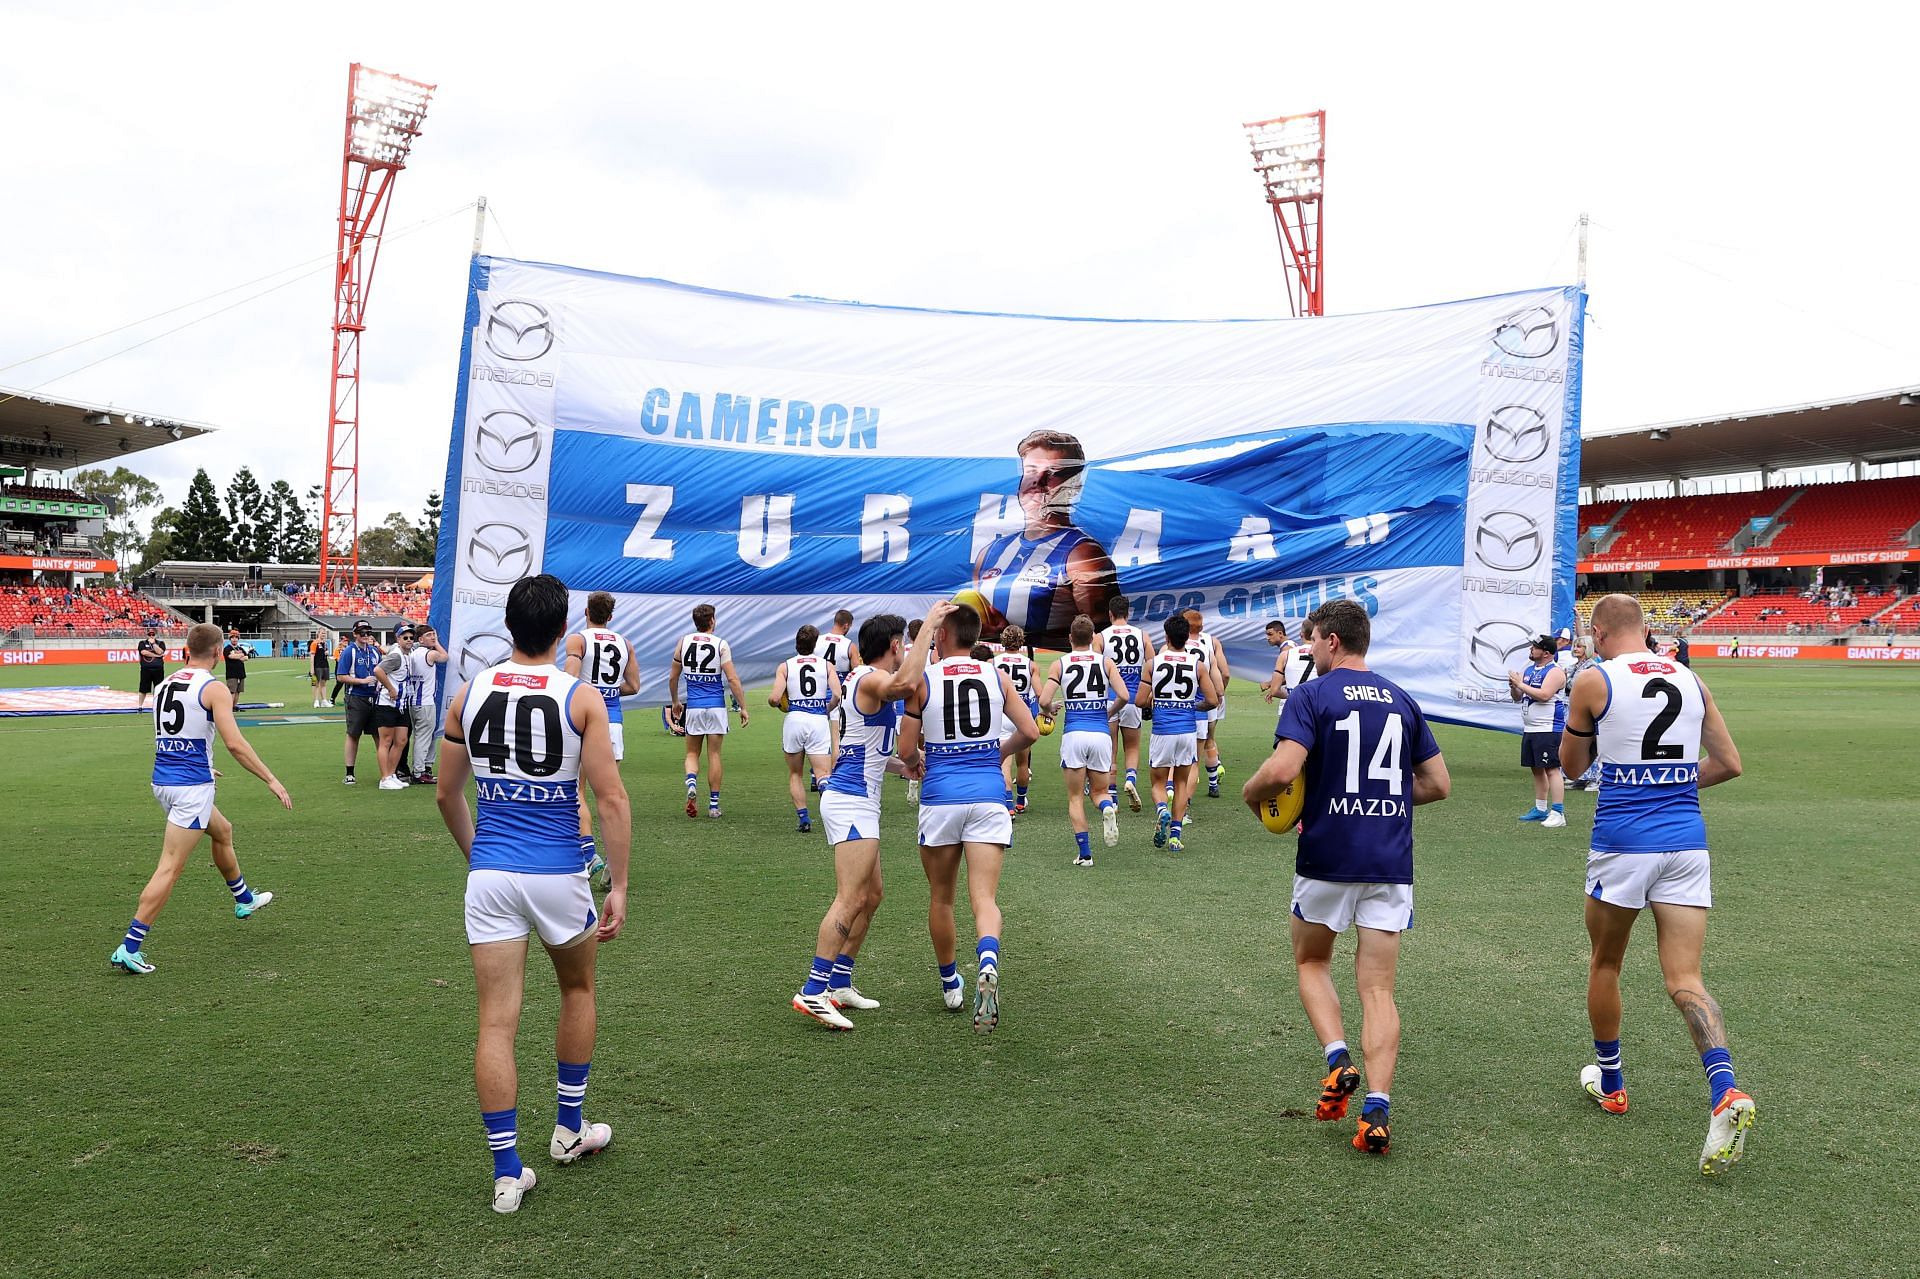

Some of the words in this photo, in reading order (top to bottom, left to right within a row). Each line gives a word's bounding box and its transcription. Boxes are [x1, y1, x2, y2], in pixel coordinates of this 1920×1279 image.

[472, 365, 554, 388] mazda
[1481, 361, 1563, 384] mazda
[640, 387, 880, 449] CAMERON
[463, 477, 545, 500] mazda
[1471, 467, 1554, 489] mazda
[33, 559, 64, 569] GIANTS
[74, 560, 96, 569] SHOP
[1593, 563, 1625, 571] GIANTS
[1635, 561, 1660, 570] SHOP
[1707, 559, 1743, 568] GIANTS
[1752, 557, 1779, 566] SHOP
[1830, 553, 1869, 563] GIANTS
[1879, 551, 1909, 561] SHOP
[1462, 575, 1549, 597] mazda
[456, 588, 509, 608] maz
[1218, 576, 1379, 619] GAMES
[3, 651, 44, 663] SHOP
[107, 651, 139, 662] GIAN
[683, 642, 716, 673] 42
[1109, 634, 1139, 665] 38
[1768, 647, 1799, 657] SHOP
[1847, 648, 1889, 659] GIANTS
[1903, 649, 1920, 660] SH
[591, 642, 621, 685] 13
[685, 674, 718, 683] MAZDA
[799, 664, 817, 697] 6
[1065, 663, 1106, 698] 24
[1154, 663, 1194, 700] 25
[791, 699, 826, 708] MAZDA
[1154, 701, 1193, 709] MAZDA
[1343, 685, 1394, 704] SHIELS
[1457, 686, 1514, 703] maz
[154, 682, 190, 735] 15
[943, 678, 992, 741] 10
[1066, 701, 1107, 711] MAZDA
[1641, 677, 1684, 760] 2
[469, 691, 564, 777] 40
[1335, 710, 1404, 796] 14
[1614, 766, 1698, 785] MAZDA
[475, 781, 568, 802] MAZDA
[1328, 797, 1407, 818] MAZDA
